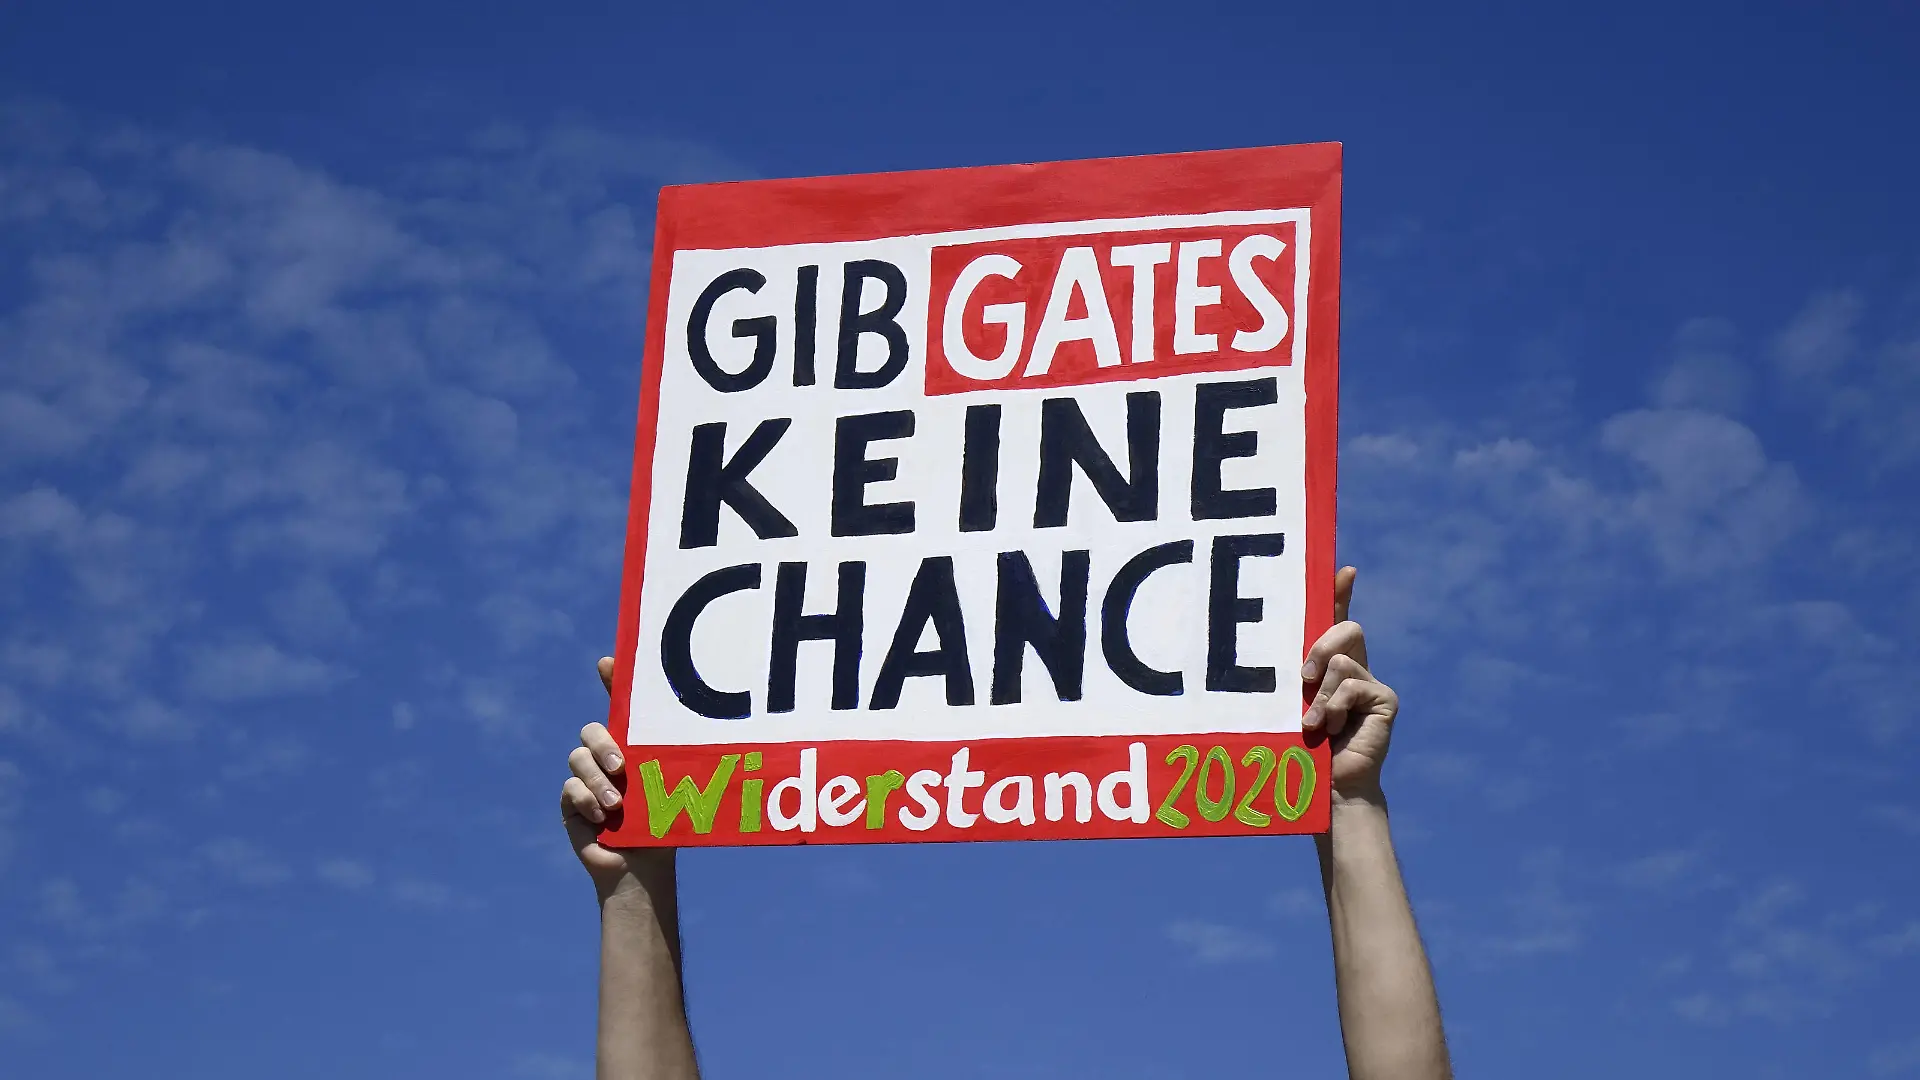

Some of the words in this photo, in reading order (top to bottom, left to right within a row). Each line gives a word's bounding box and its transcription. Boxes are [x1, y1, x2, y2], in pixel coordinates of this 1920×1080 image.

[686, 259, 910, 394] GIB
[942, 234, 1289, 381] GATES
[678, 376, 1279, 550] KEINE
[660, 532, 1286, 720] CHANCE
